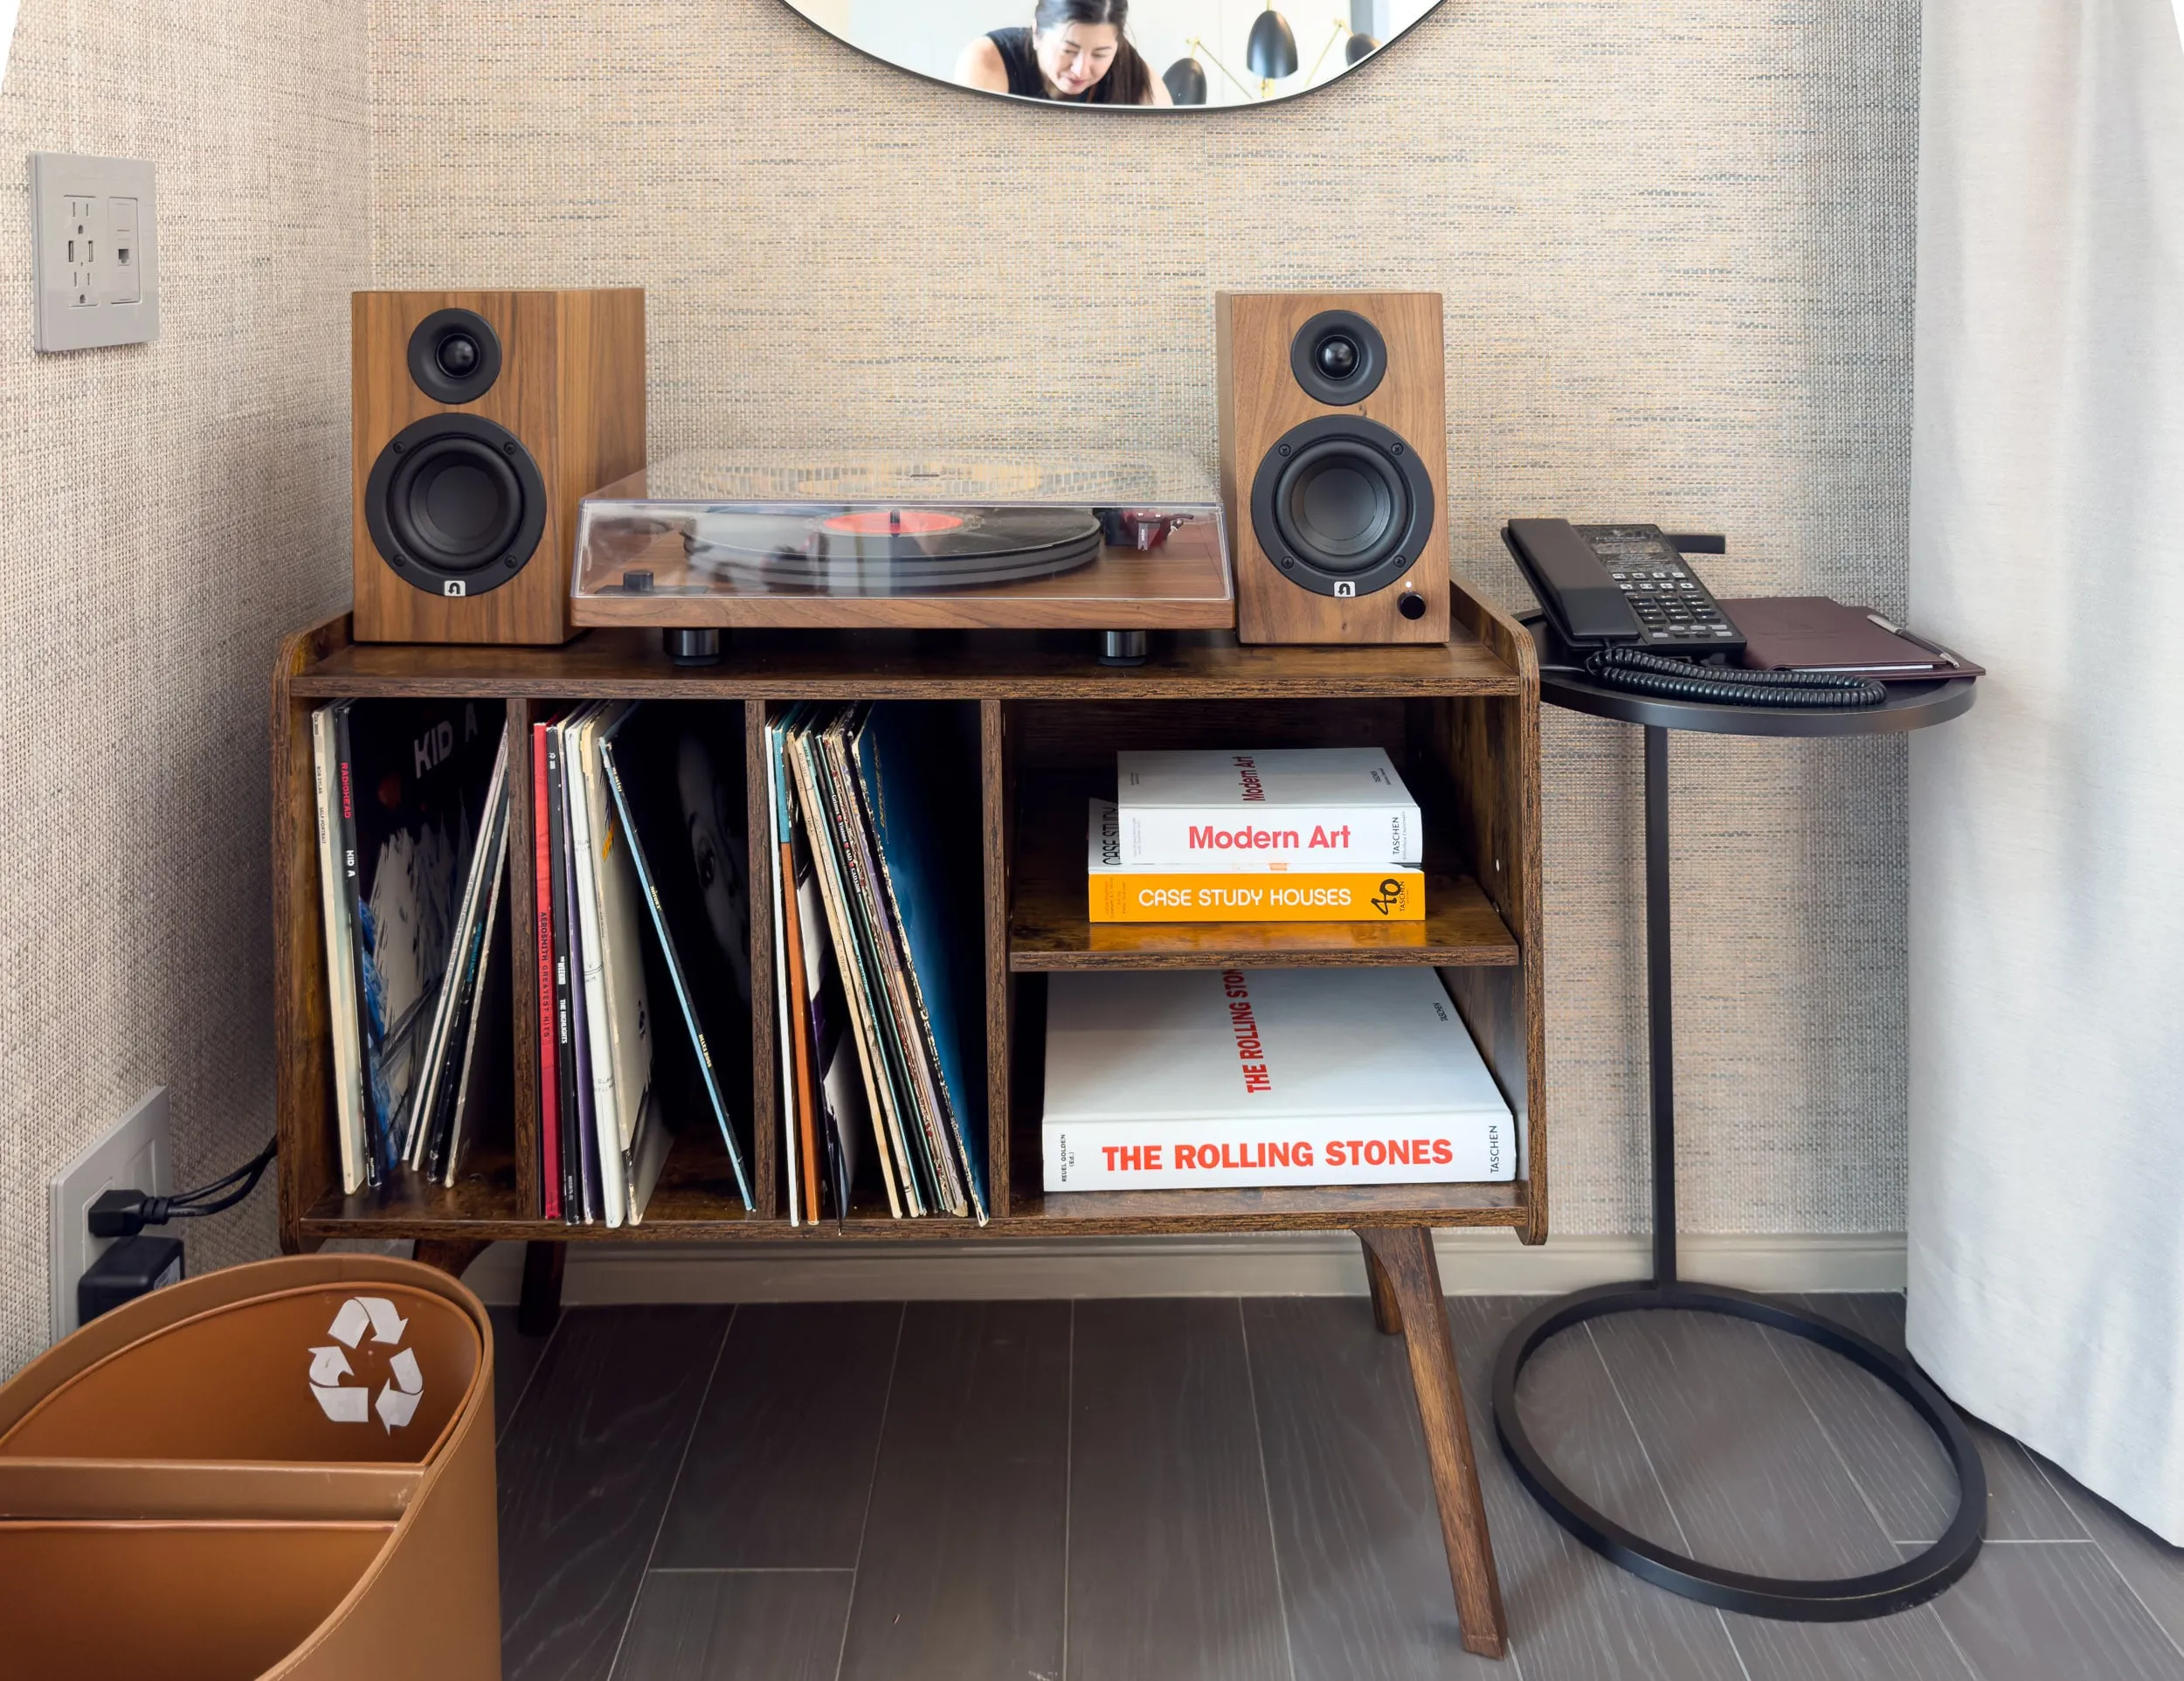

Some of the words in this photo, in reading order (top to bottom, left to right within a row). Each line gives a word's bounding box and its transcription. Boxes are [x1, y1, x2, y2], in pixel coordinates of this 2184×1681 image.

[414, 721, 453, 779] KID
[465, 702, 479, 744] A
[1231, 756, 1255, 769] Art
[341, 762, 352, 819] RADIOHEAD
[1238, 770, 1266, 801] Modern
[838, 821, 847, 843] Visions
[1189, 825, 1299, 849] Modern
[1308, 825, 1351, 849] Art
[346, 850, 356, 866] KID
[1138, 889, 1192, 907] CASE
[1198, 888, 1263, 907] STUDY
[1270, 888, 1351, 906] HOUSES
[540, 911, 549, 961] AEROSMITH
[1228, 1002, 1264, 1059] ROLLING
[1242, 1064, 1272, 1093] THE
[1102, 1145, 1162, 1171] THE
[1174, 1141, 1313, 1169] ROLLING
[1325, 1138, 1454, 1166] STONES
[1489, 1125, 1500, 1173] TASCHEN
